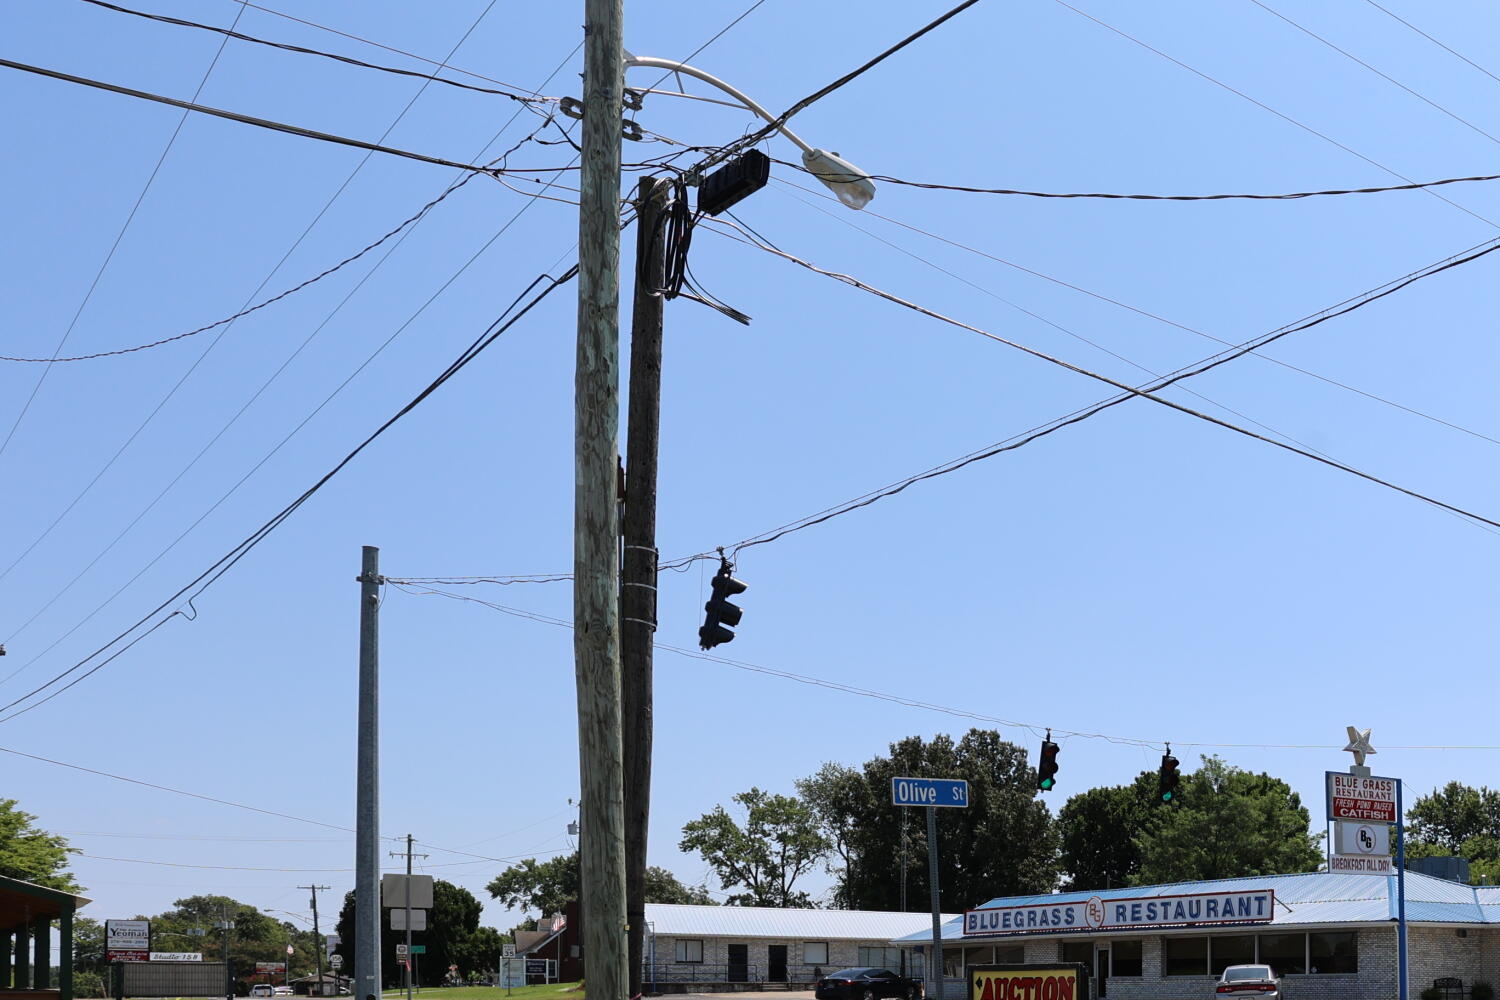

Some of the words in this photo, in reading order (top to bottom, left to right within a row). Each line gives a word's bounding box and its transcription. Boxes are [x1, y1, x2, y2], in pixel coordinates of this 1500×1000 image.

[1335, 776, 1358, 789] BLUE
[1362, 779, 1392, 792] GRASS
[898, 781, 937, 802] Olive
[952, 786, 965, 801] St
[1336, 787, 1392, 800] RESTAURANT
[1335, 798, 1355, 808] FRESH
[1340, 808, 1389, 820] CATFISH
[1331, 857, 1366, 871] BREAKFAST
[1366, 859, 1378, 872] ALL
[1378, 860, 1391, 873] DAY
[968, 907, 1076, 931] BLUEGRASS
[1115, 895, 1268, 923] RESTAURANT
[110, 927, 148, 937] Yeoman
